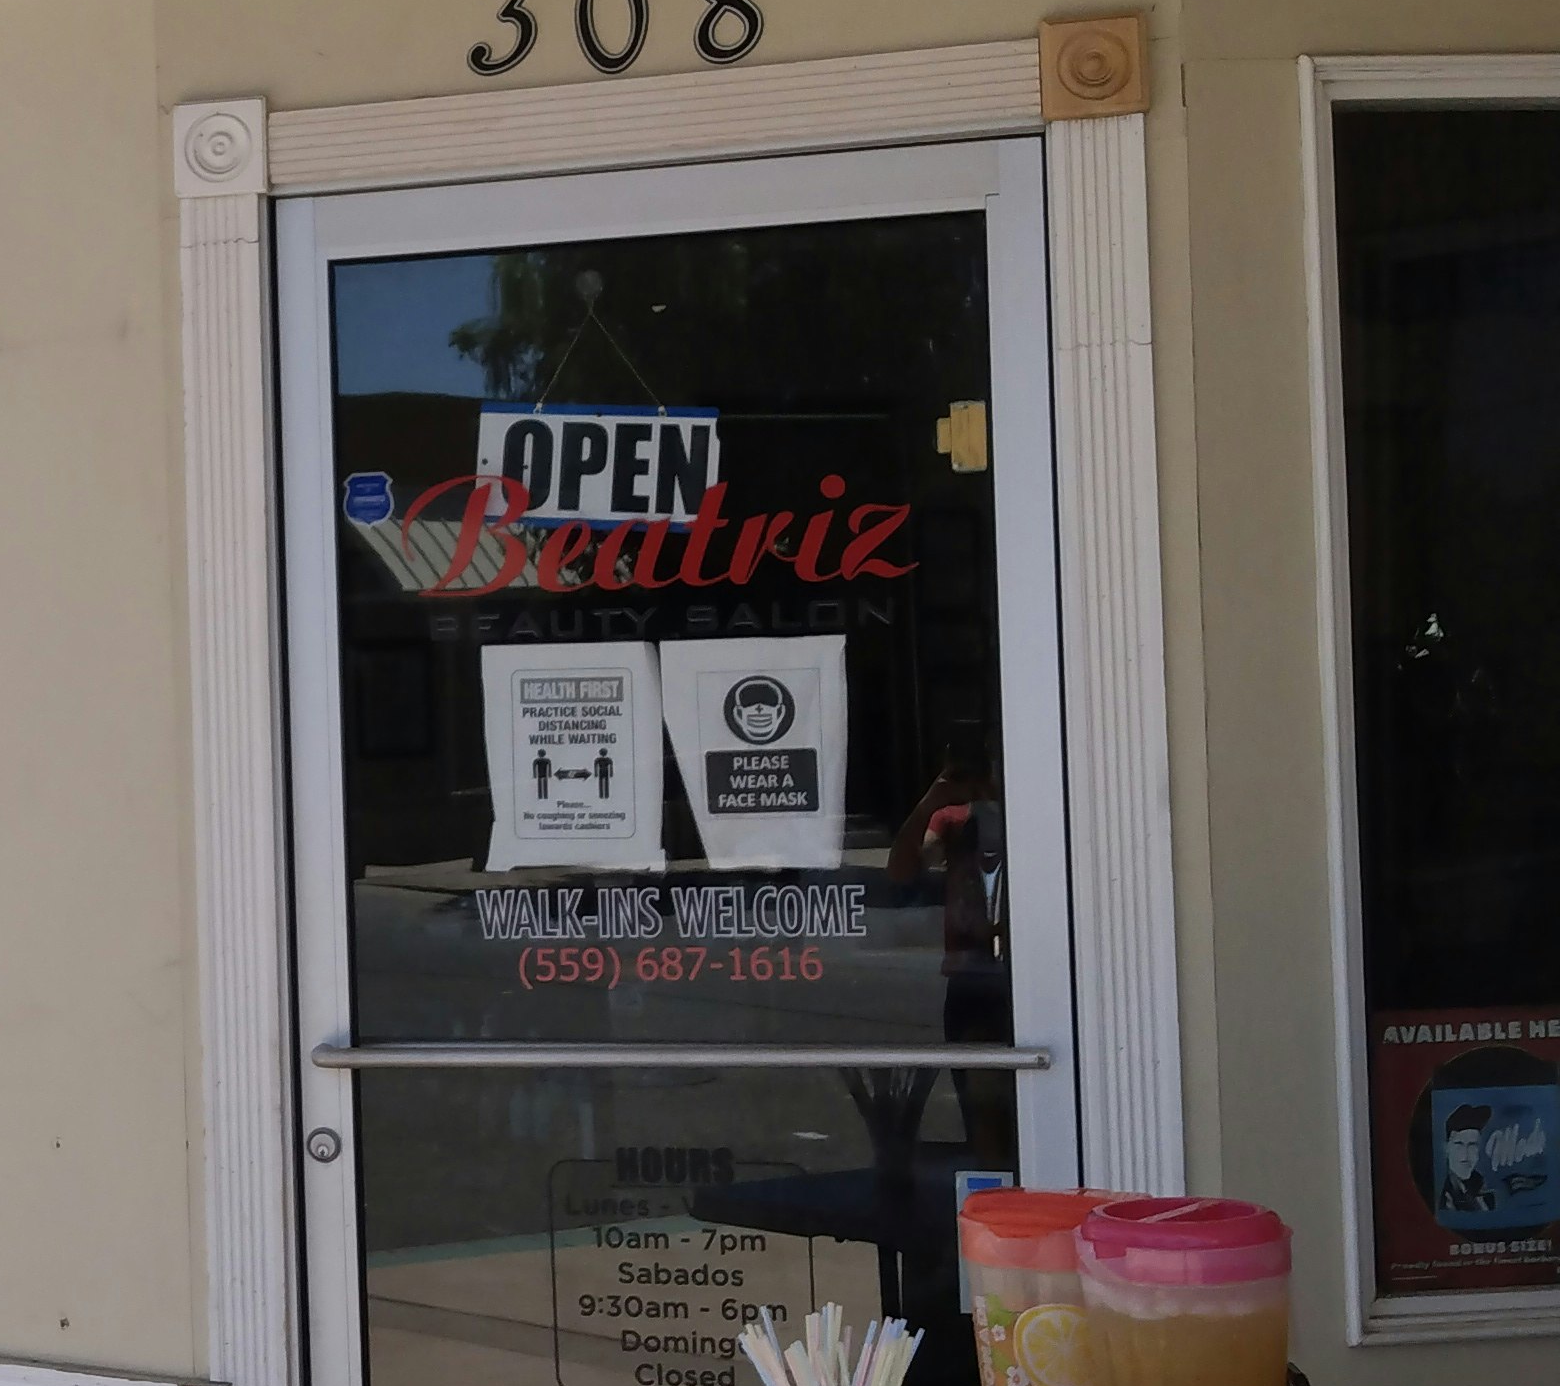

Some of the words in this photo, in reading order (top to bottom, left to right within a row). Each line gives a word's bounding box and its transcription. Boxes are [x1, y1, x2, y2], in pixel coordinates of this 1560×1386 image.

[501, 417, 712, 516] OPEN
[400, 474, 921, 598] Beatriz
[429, 605, 657, 642] BEAUTY
[686, 597, 895, 633] SALON
[523, 681, 575, 700] HEALTH
[580, 680, 620, 698] FIRST
[522, 706, 577, 718] PRACTICE
[581, 705, 622, 717] SOCIAL
[538, 719, 607, 731] DISTANCING
[529, 734, 564, 745] WHILE
[568, 733, 617, 744] WAITING
[732, 755, 790, 771] PLEASE
[729, 774, 779, 789] WEAR
[782, 773, 794, 788] A
[718, 793, 756, 808] FACE
[760, 791, 808, 807] MASK
[476, 887, 663, 940] WALK-INS
[670, 884, 867, 938] WELCOME
[518, 947, 622, 989] (559)
[636, 946, 824, 982] 687-1616
[1383, 1020, 1522, 1044] AVAILABLE
[615, 1147, 735, 1184] HOURS
[566, 1192, 649, 1216] Lunes
[593, 1226, 669, 1249] 10am
[701, 1228, 767, 1255] 7pm
[618, 1262, 744, 1287] Sabados
[579, 1294, 689, 1318] 9:30am
